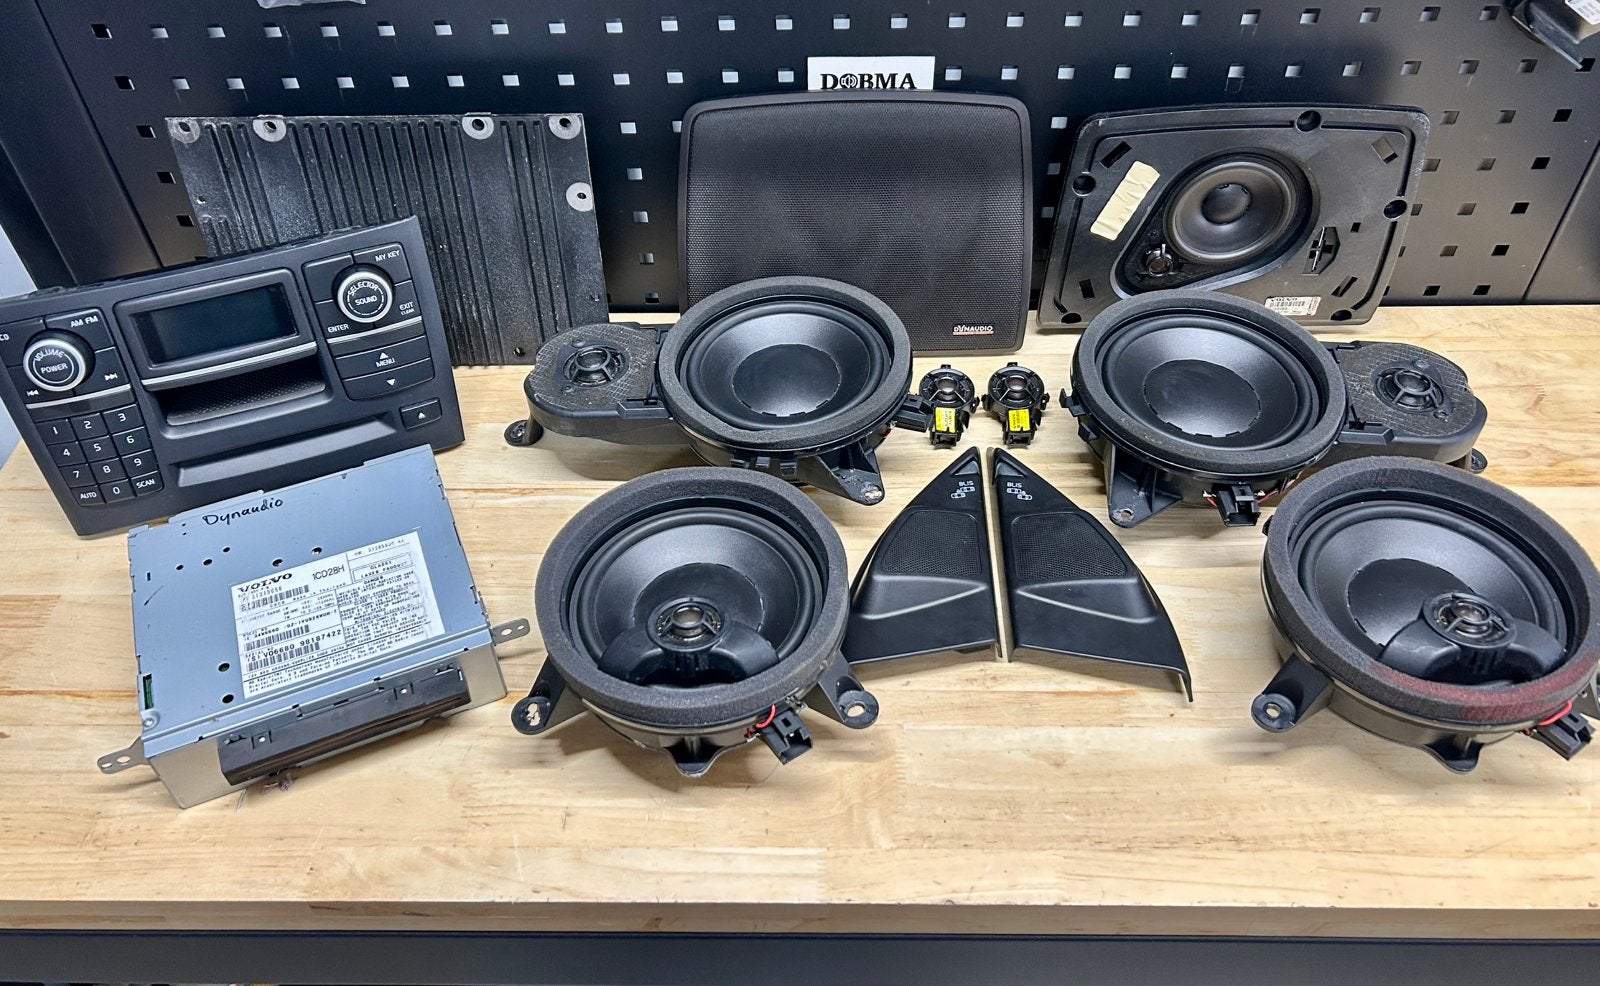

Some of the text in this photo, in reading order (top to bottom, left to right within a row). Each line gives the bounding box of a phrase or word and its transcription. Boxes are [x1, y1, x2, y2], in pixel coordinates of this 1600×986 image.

[388, 250, 400, 258] KEY
[348, 281, 379, 296] SELECTOR
[355, 295, 377, 305] SOUND
[400, 302, 413, 310] EXIT
[70, 316, 98, 328] AM FM
[328, 323, 349, 333] ENTER
[34, 348, 65, 362] VOLUME
[376, 358, 395, 367] MENU
[41, 362, 68, 374] POWER
[118, 413, 127, 422] 3
[84, 421, 92, 429] 2
[126, 435, 135, 443] 6
[93, 443, 101, 451] 5
[134, 458, 142, 466] 9
[103, 465, 111, 473] 8
[136, 479, 155, 488] SCAN
[80, 491, 97, 499] AUTO
[202, 497, 284, 526] Dynaudio
[238, 573, 292, 592] VOLVO
[299, 628, 341, 646] 98187422
